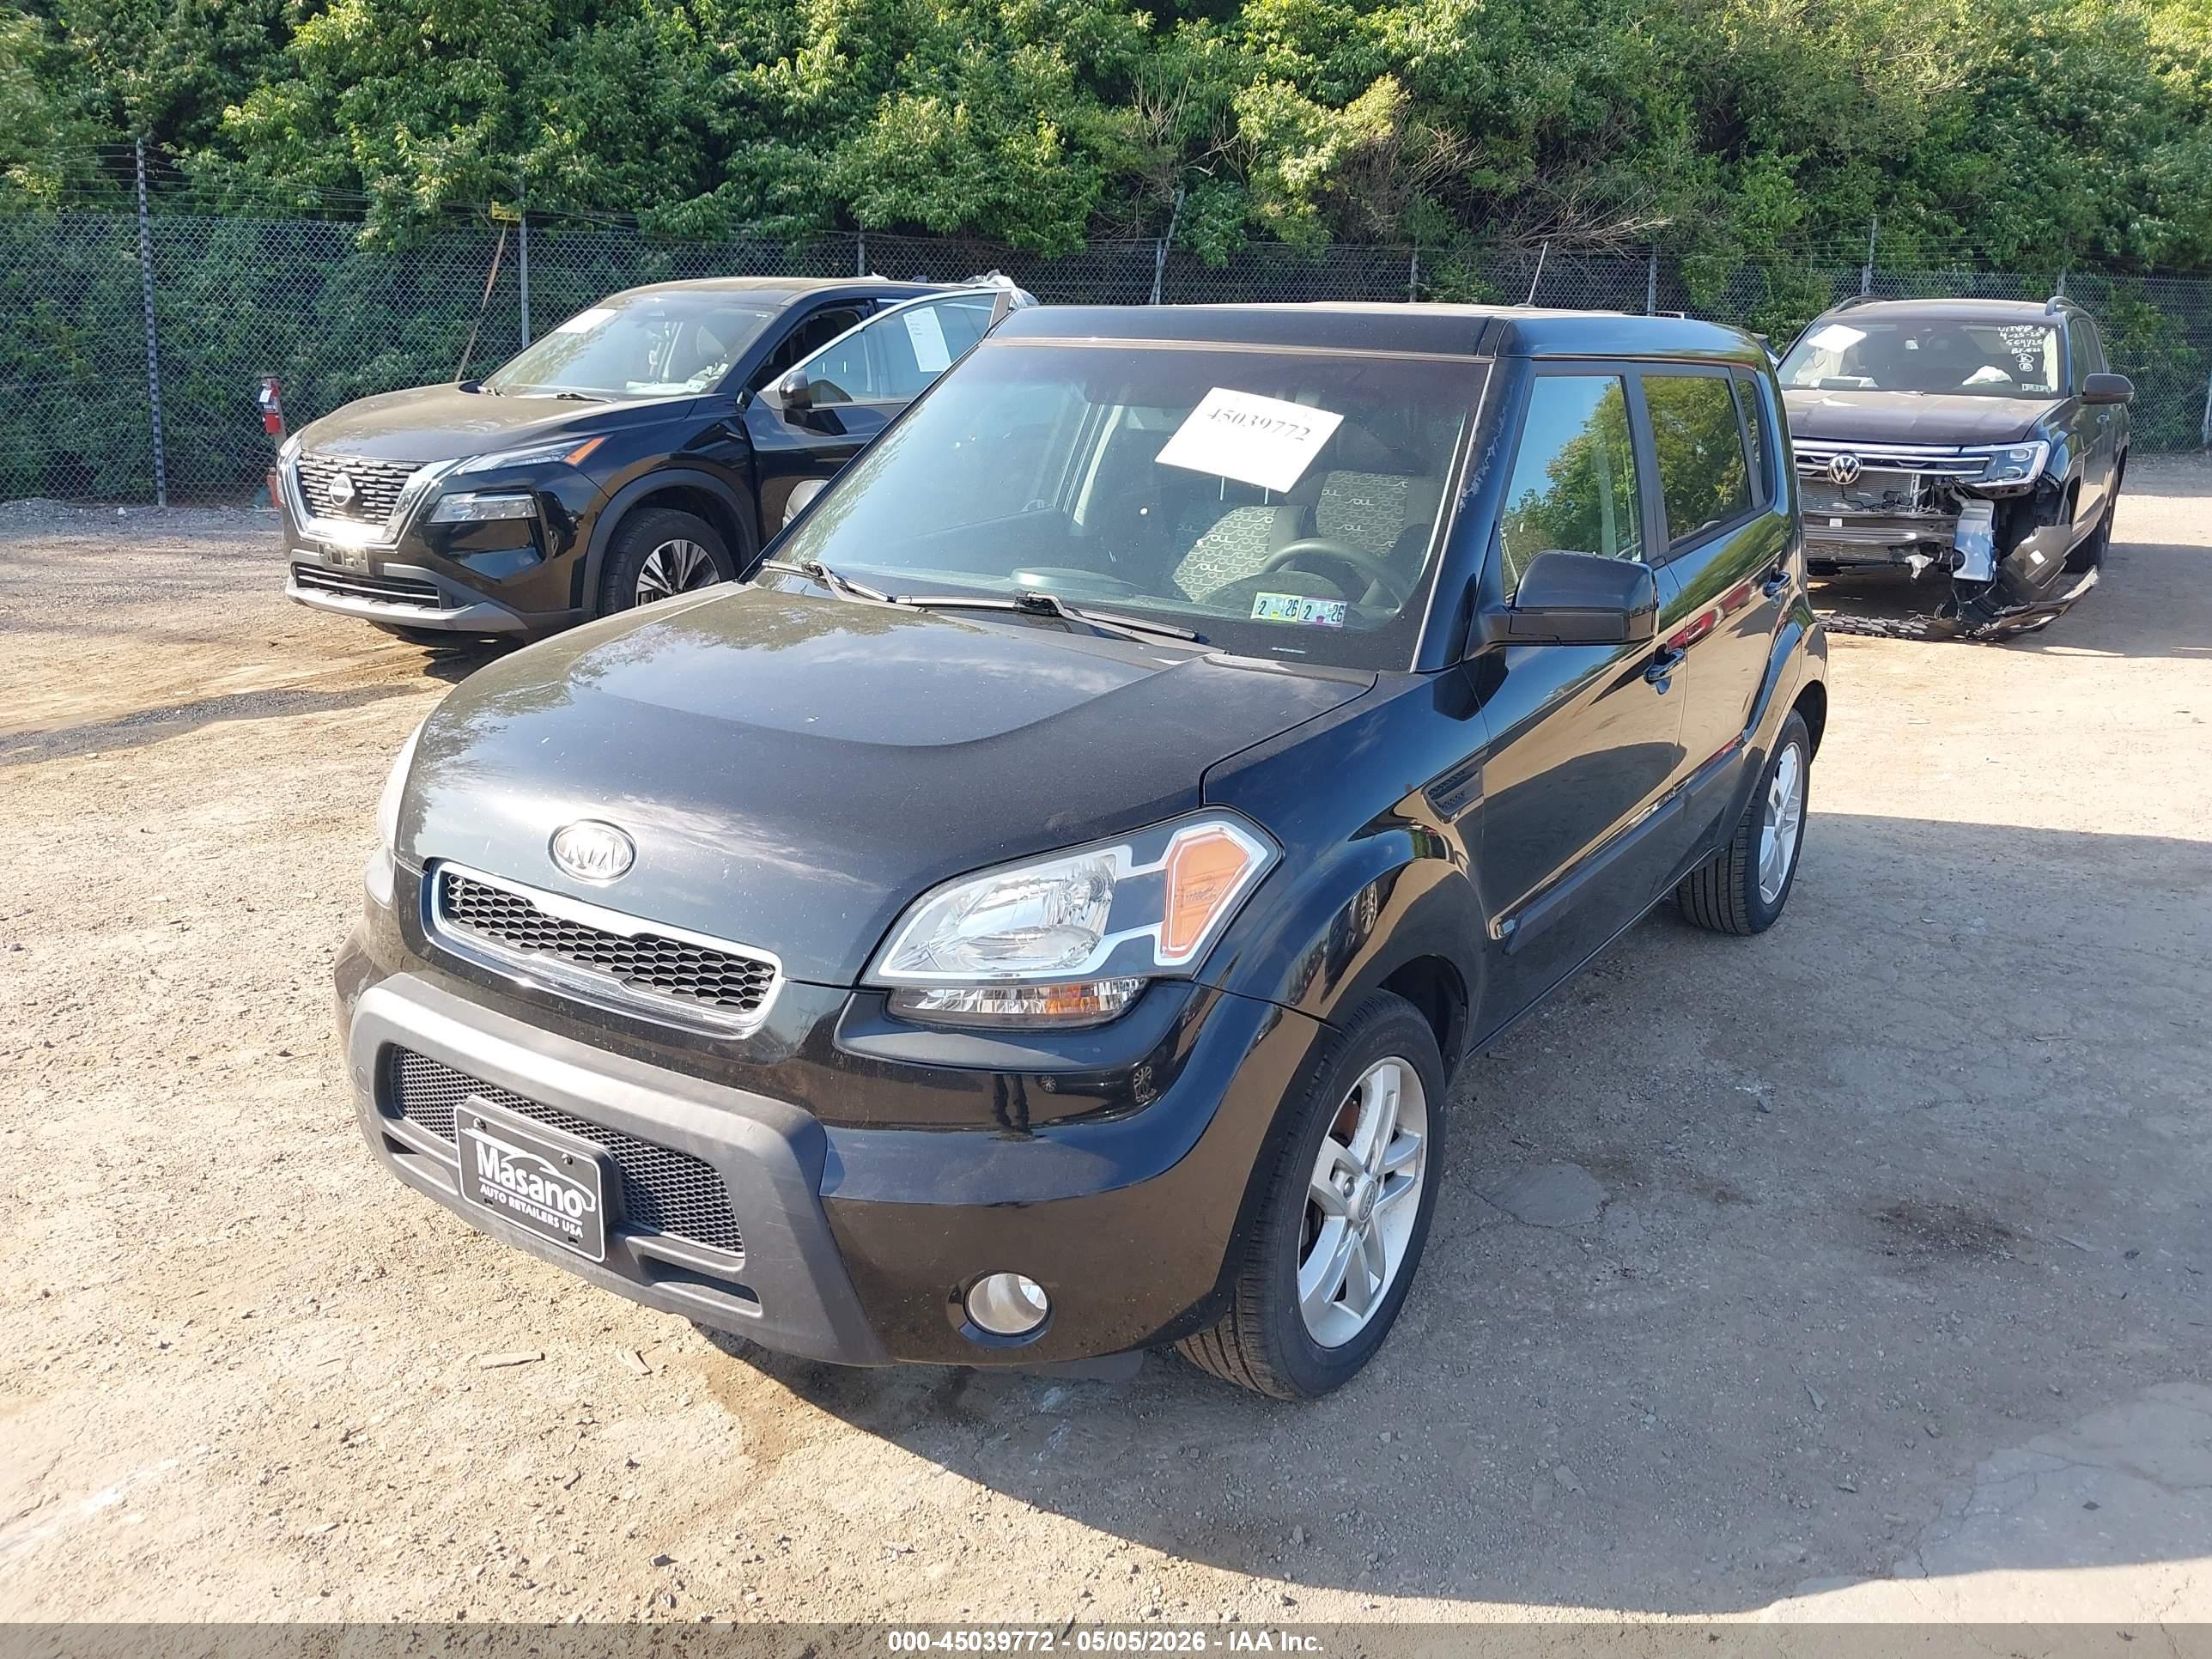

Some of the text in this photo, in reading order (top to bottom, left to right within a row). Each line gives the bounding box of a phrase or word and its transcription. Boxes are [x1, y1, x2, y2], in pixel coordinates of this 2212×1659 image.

[1206, 406, 1311, 442] 45039772
[1258, 599, 1345, 623] 2 26 2 26
[476, 1139, 585, 1218] Masano
[479, 1184, 584, 1238] AUTO RETAILERS USA
